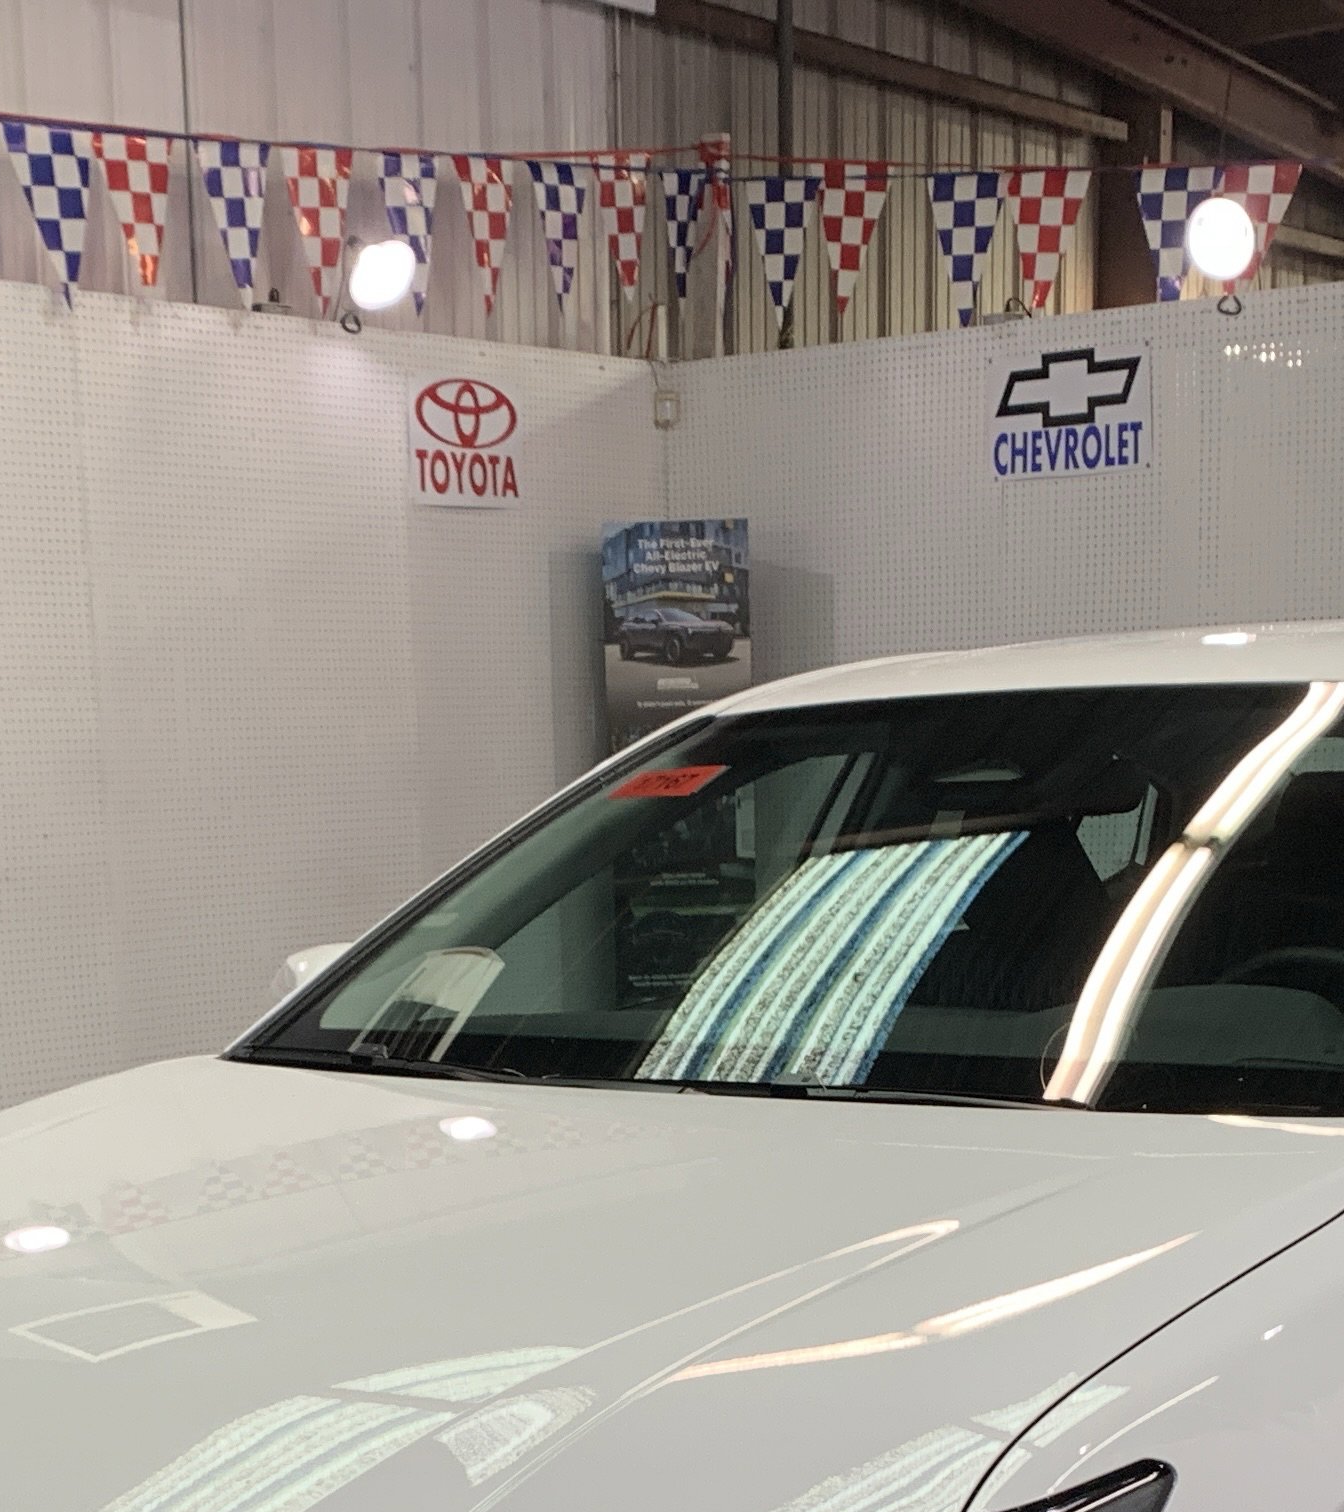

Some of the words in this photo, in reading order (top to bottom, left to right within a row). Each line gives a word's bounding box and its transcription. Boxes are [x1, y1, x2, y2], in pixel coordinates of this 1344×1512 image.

[994, 421, 1142, 475] CHEVROLET
[416, 449, 519, 498] TOYOTA
[637, 539, 658, 550] The
[633, 563, 666, 575] Chevy
[668, 562, 703, 573] Blazer
[705, 560, 720, 573] EV
